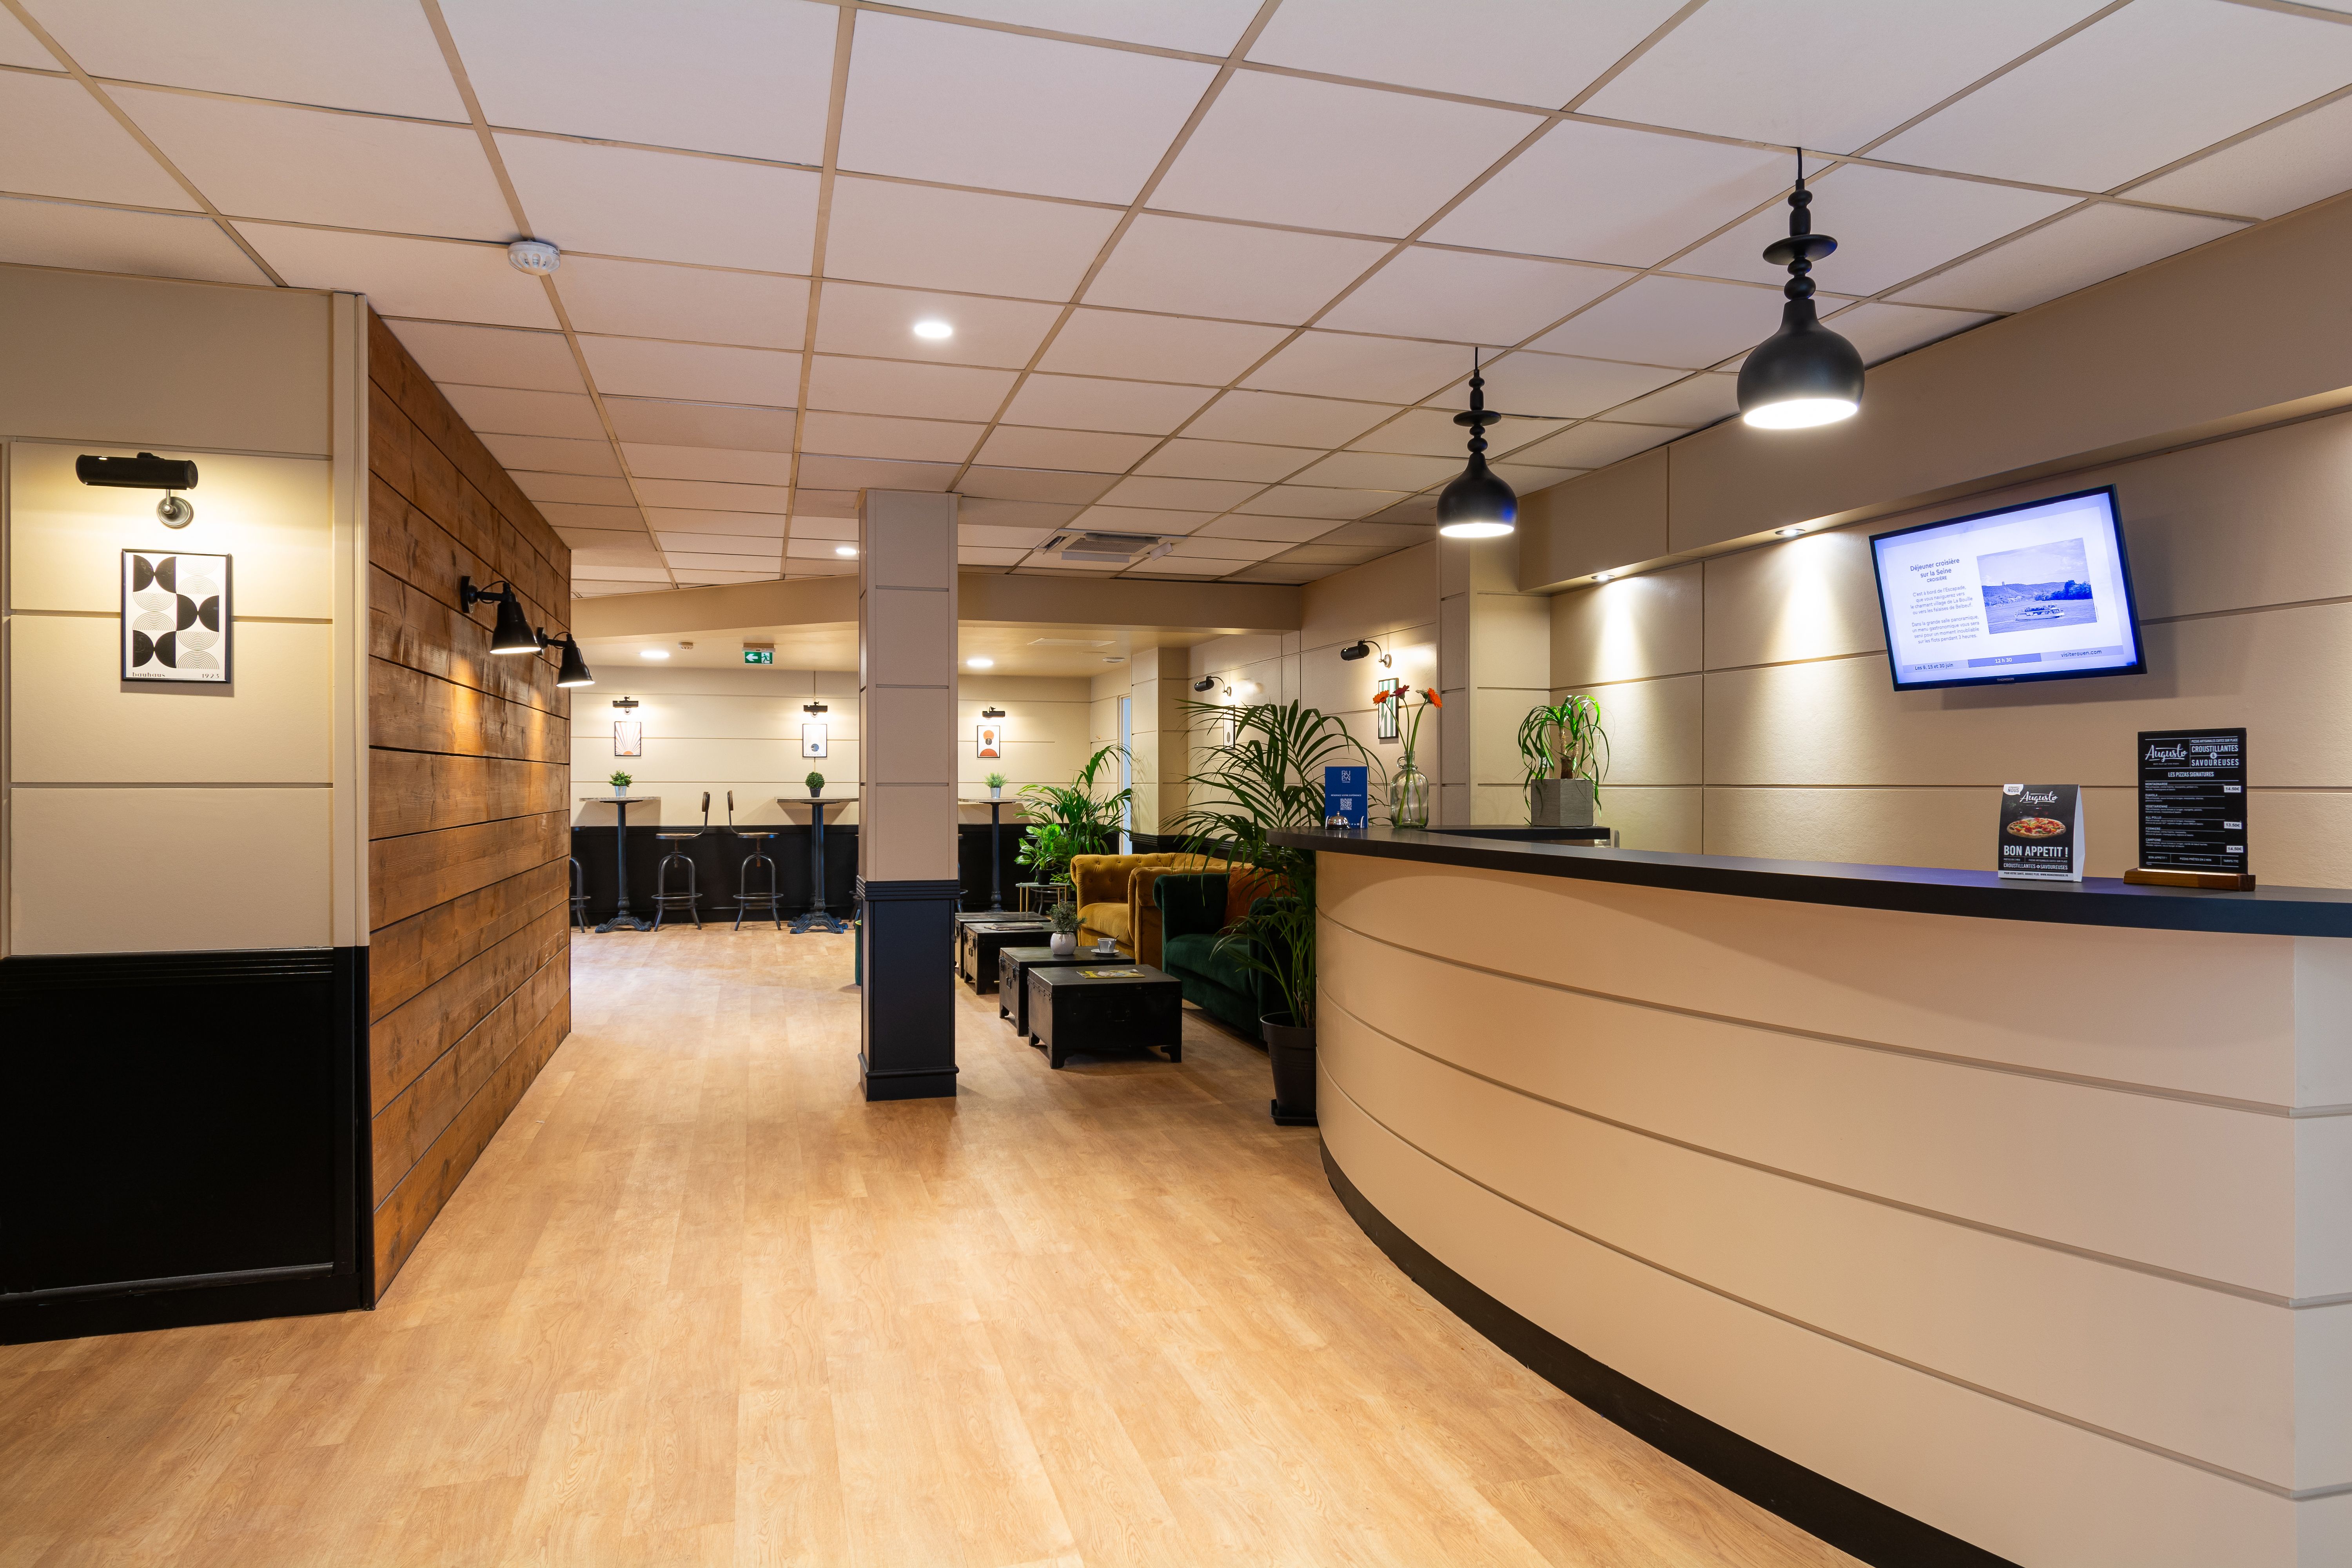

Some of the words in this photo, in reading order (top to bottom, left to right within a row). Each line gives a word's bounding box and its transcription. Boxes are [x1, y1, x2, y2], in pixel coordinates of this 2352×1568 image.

[1910, 563, 1934, 571] Déjeuner
[2145, 744, 2188, 762] Augusto
[2020, 791, 2058, 804] Augusto
[2004, 845, 2022, 856] BON
[2025, 846, 2062, 857] APPETIT
[2065, 847, 2068, 857] !
